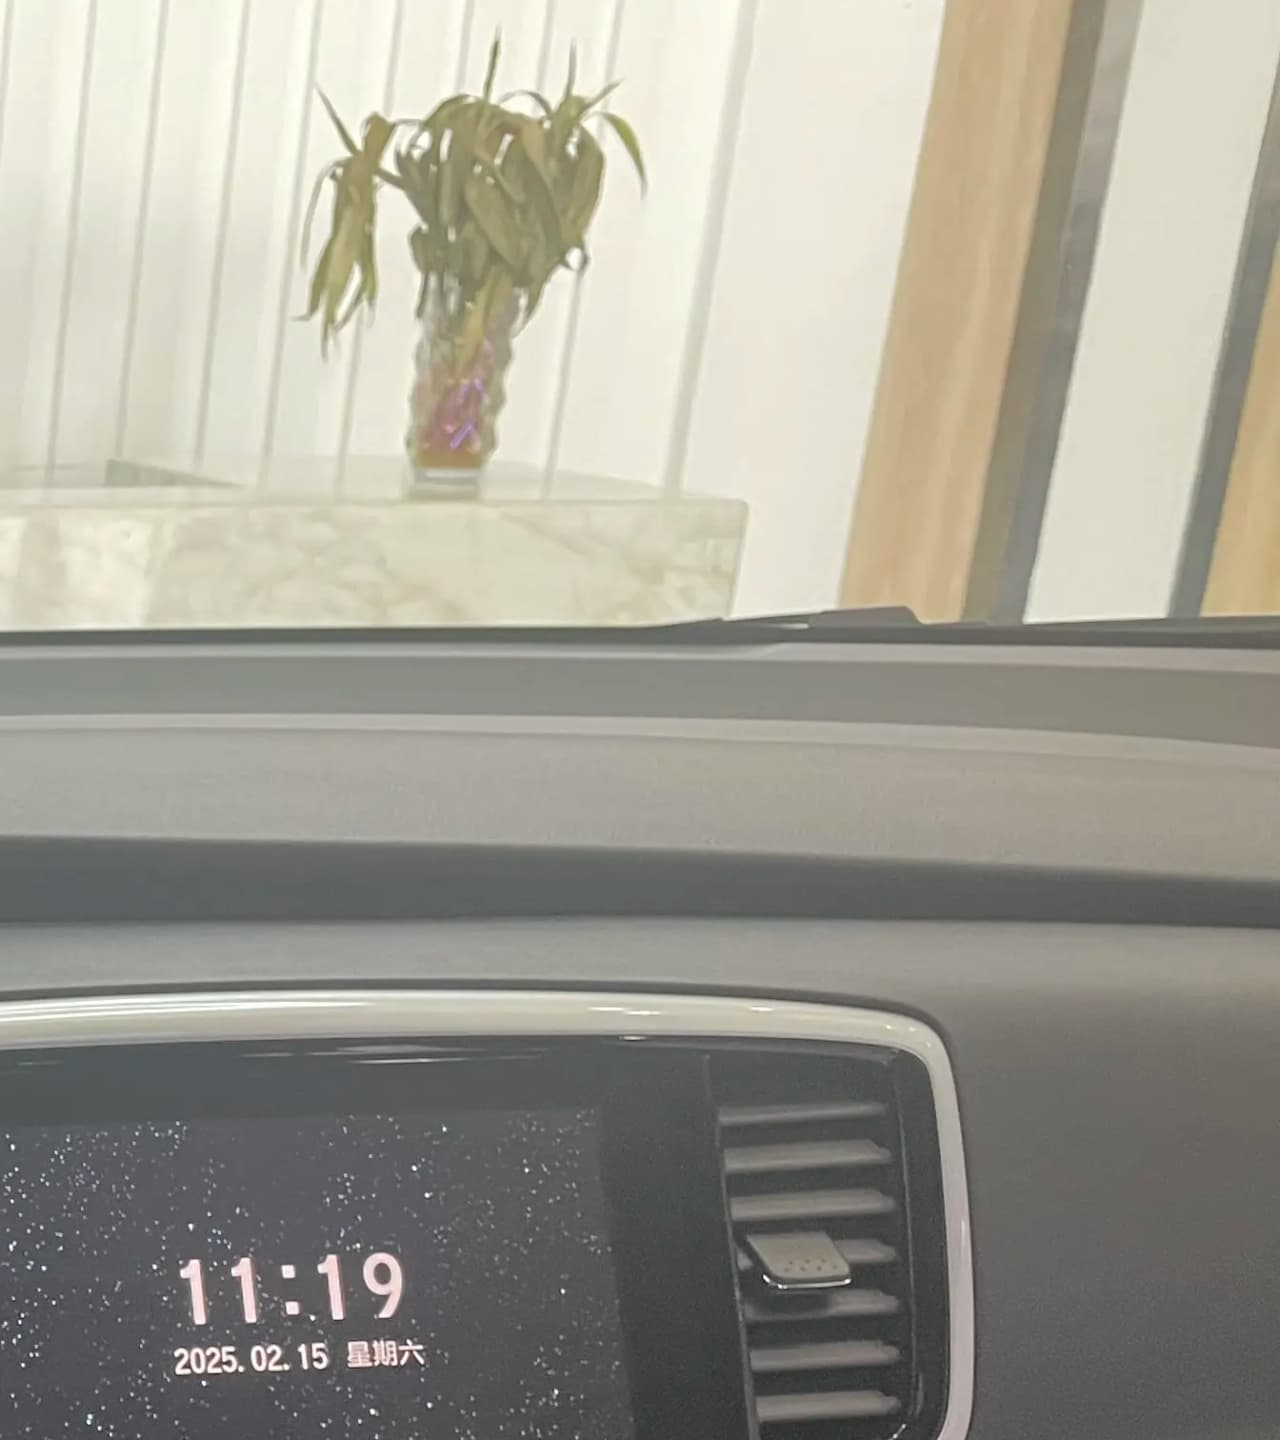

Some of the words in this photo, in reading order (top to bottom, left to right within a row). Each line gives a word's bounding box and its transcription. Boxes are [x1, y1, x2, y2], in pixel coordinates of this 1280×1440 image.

[179, 1252, 404, 1326] 11:19
[346, 1339, 425, 1368] 星期六
